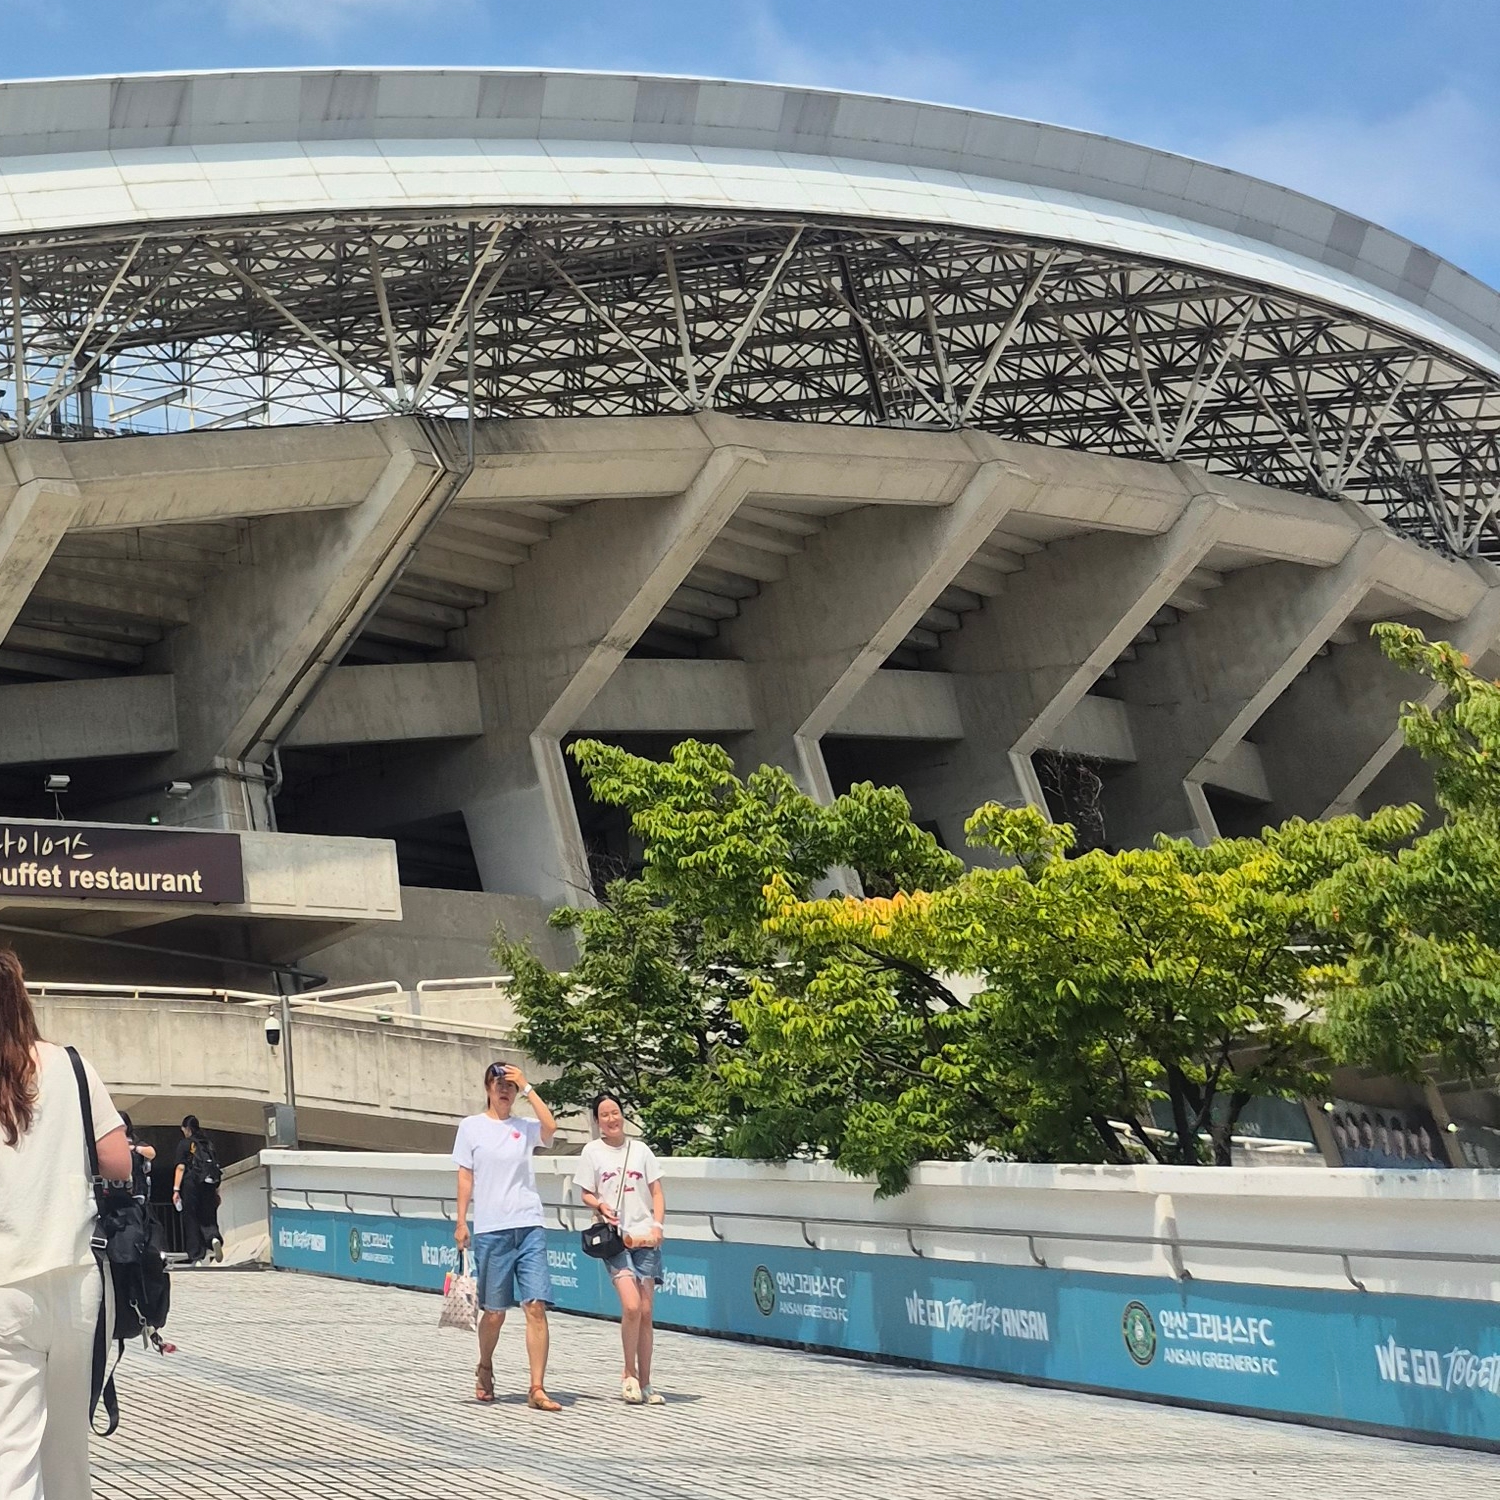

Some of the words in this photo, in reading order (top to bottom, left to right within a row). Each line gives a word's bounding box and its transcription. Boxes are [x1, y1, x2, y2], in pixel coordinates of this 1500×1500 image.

[69, 867, 203, 894] restaurant
[776, 1272, 847, 1299] 안산그리너스FC
[779, 1301, 803, 1316] ANSAN
[838, 1307, 849, 1322] FC
[905, 1289, 926, 1326] WE
[926, 1299, 945, 1328] GO
[1001, 1307, 1049, 1341] ANSAN
[1159, 1309, 1276, 1347] 안산그리너스FC
[1163, 1348, 1201, 1367] ANSAN
[1202, 1351, 1262, 1374] GREENERS
[1261, 1357, 1280, 1376] FC
[1374, 1334, 1411, 1383] WE
[1409, 1348, 1442, 1387] GO
